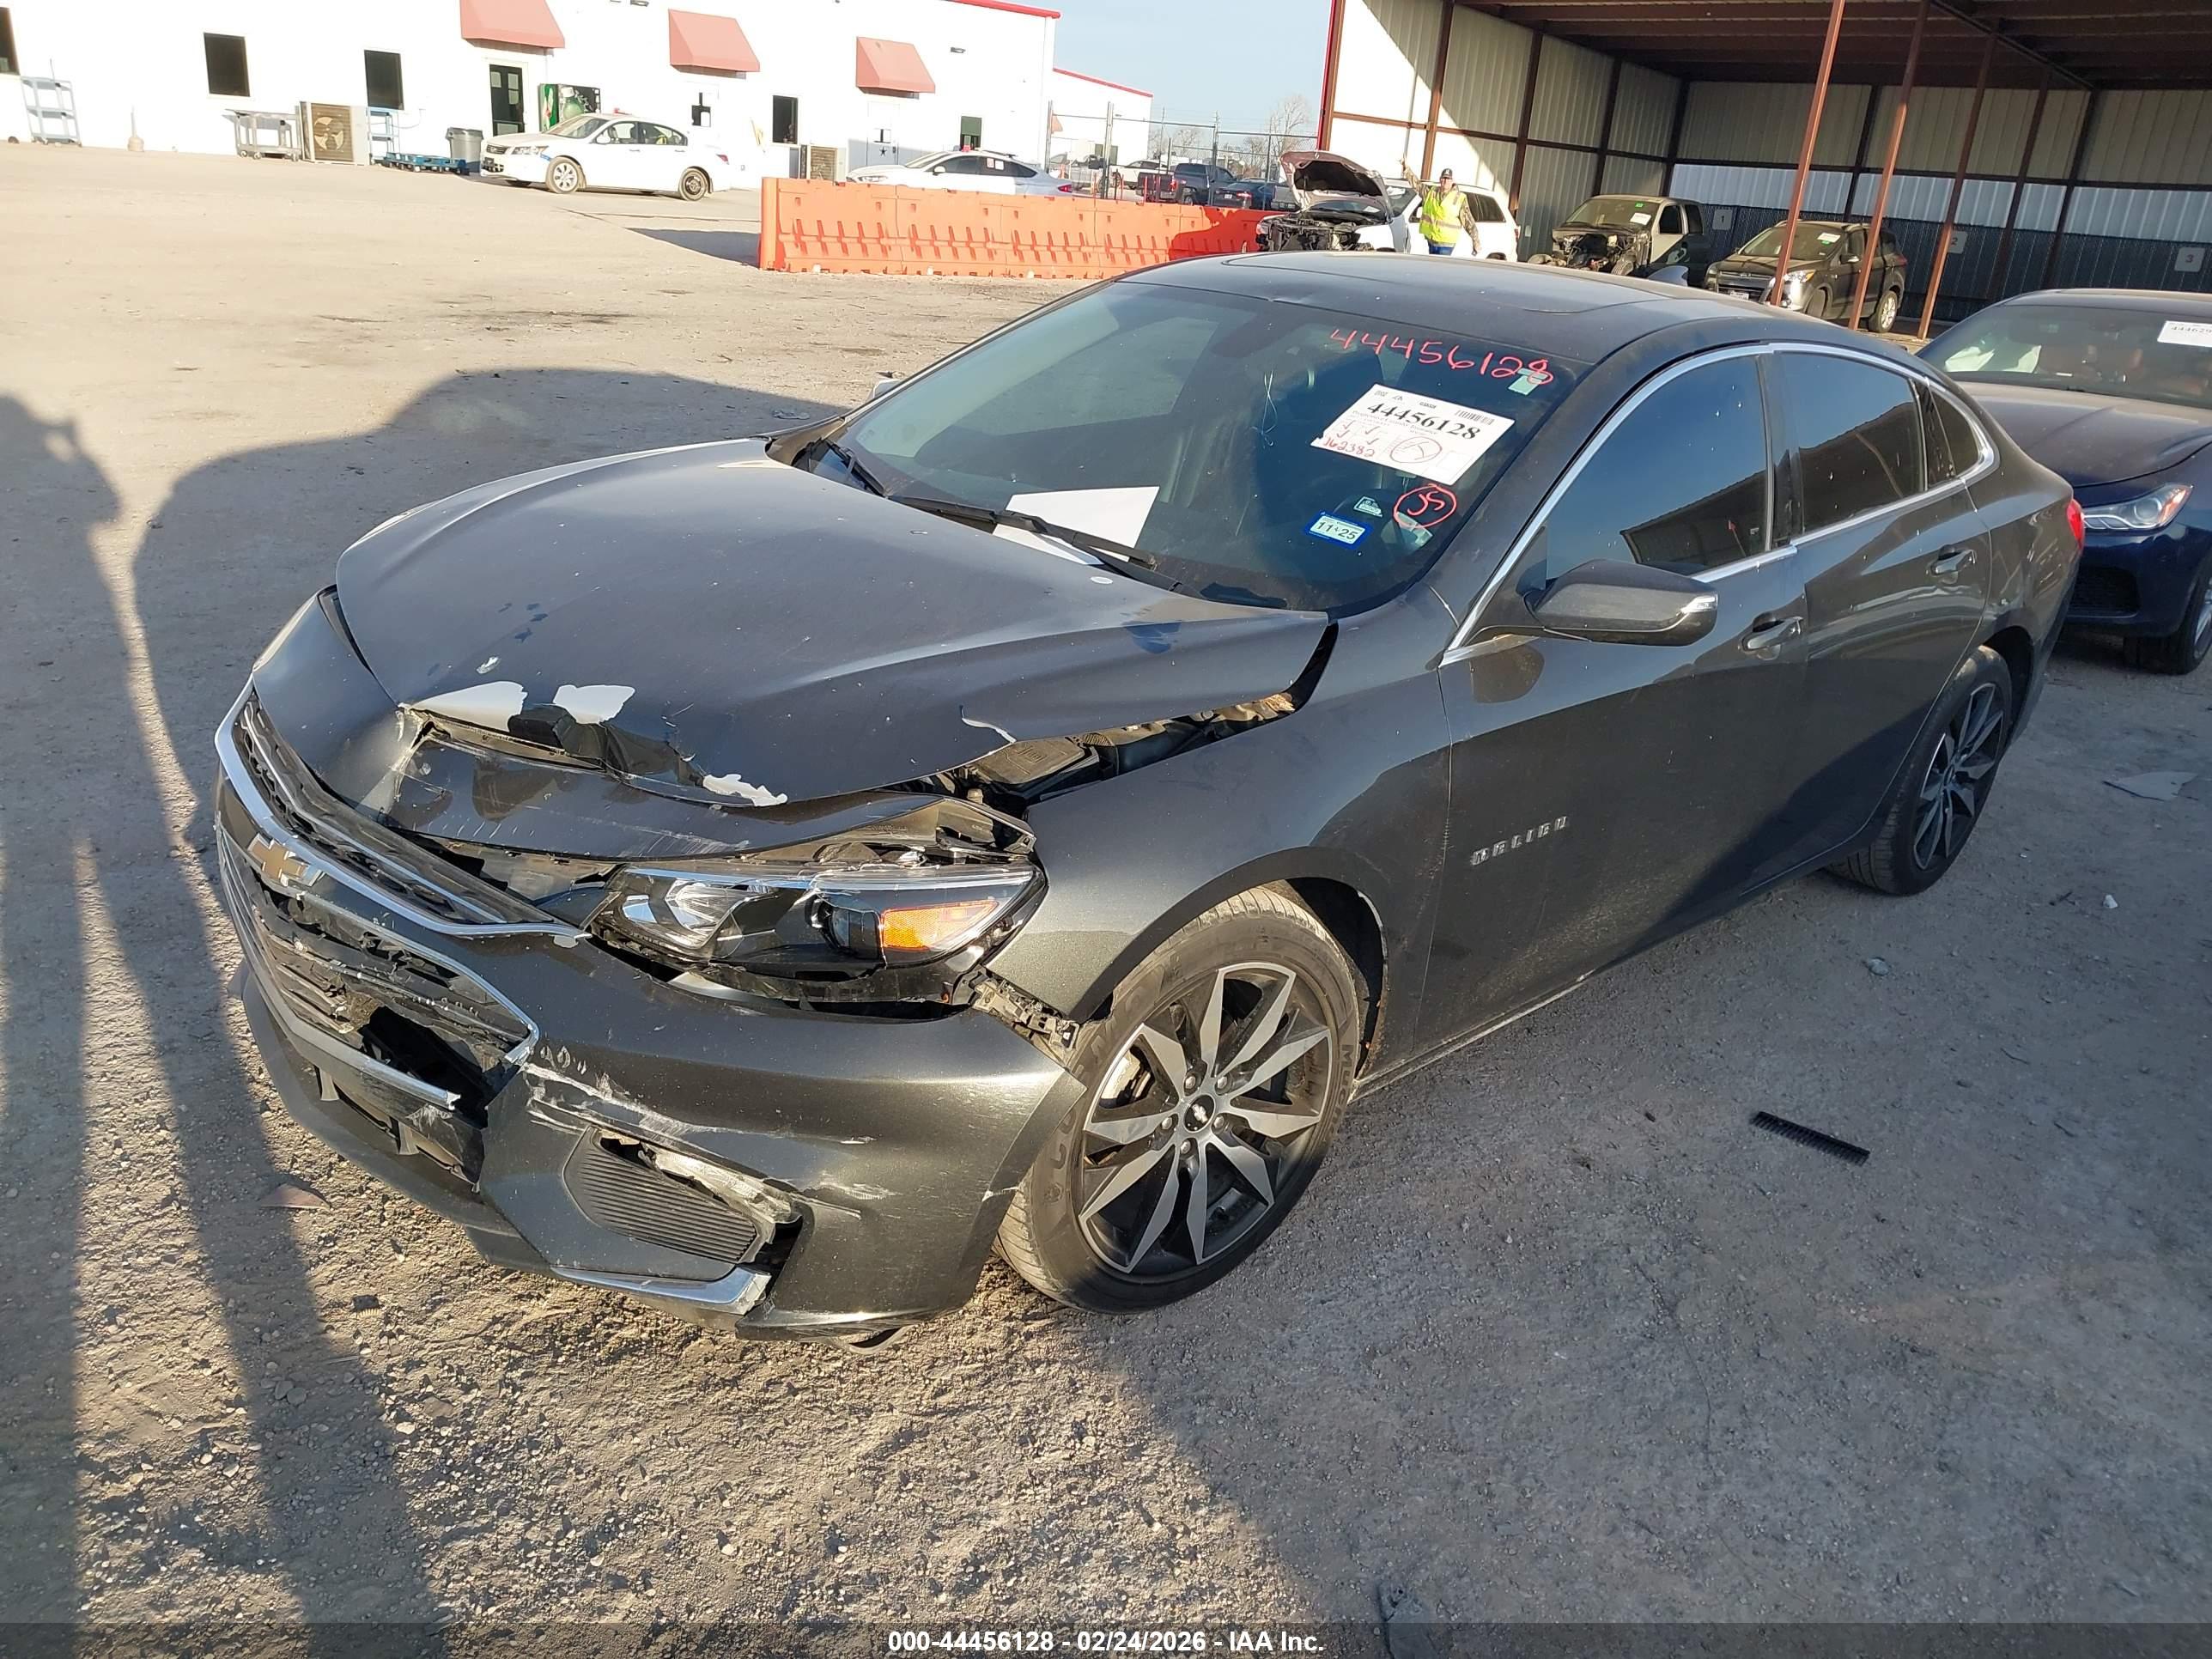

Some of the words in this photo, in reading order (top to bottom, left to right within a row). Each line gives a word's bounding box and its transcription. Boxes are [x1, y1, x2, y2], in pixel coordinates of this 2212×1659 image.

[1331, 329, 1553, 386] 44456128
[1367, 403, 1481, 440] 44456128
[1316, 522, 1332, 532] 11
[1339, 529, 1357, 541] 25
